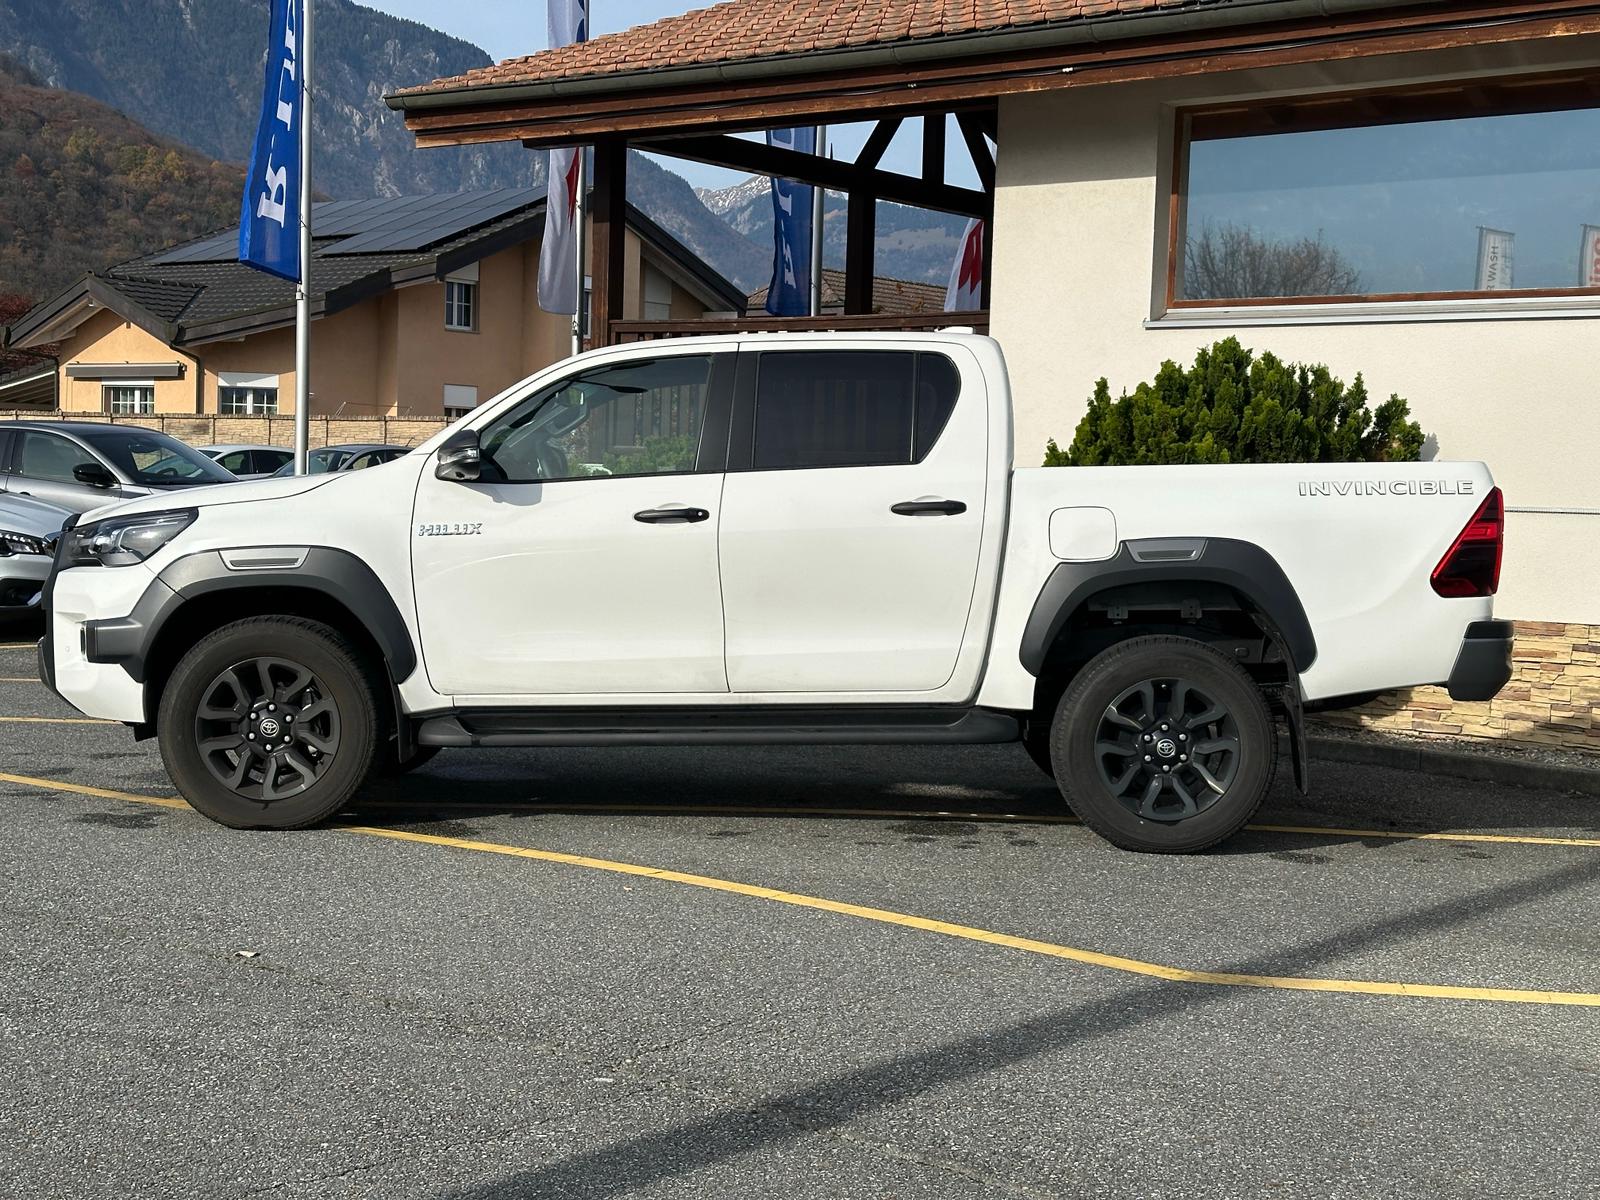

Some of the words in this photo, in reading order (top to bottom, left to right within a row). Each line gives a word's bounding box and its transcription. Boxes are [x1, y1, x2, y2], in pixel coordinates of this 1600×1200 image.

[1487, 246, 1500, 282] WASH
[1299, 480, 1474, 496] INVINCIBLE
[418, 523, 483, 537] HILUX
